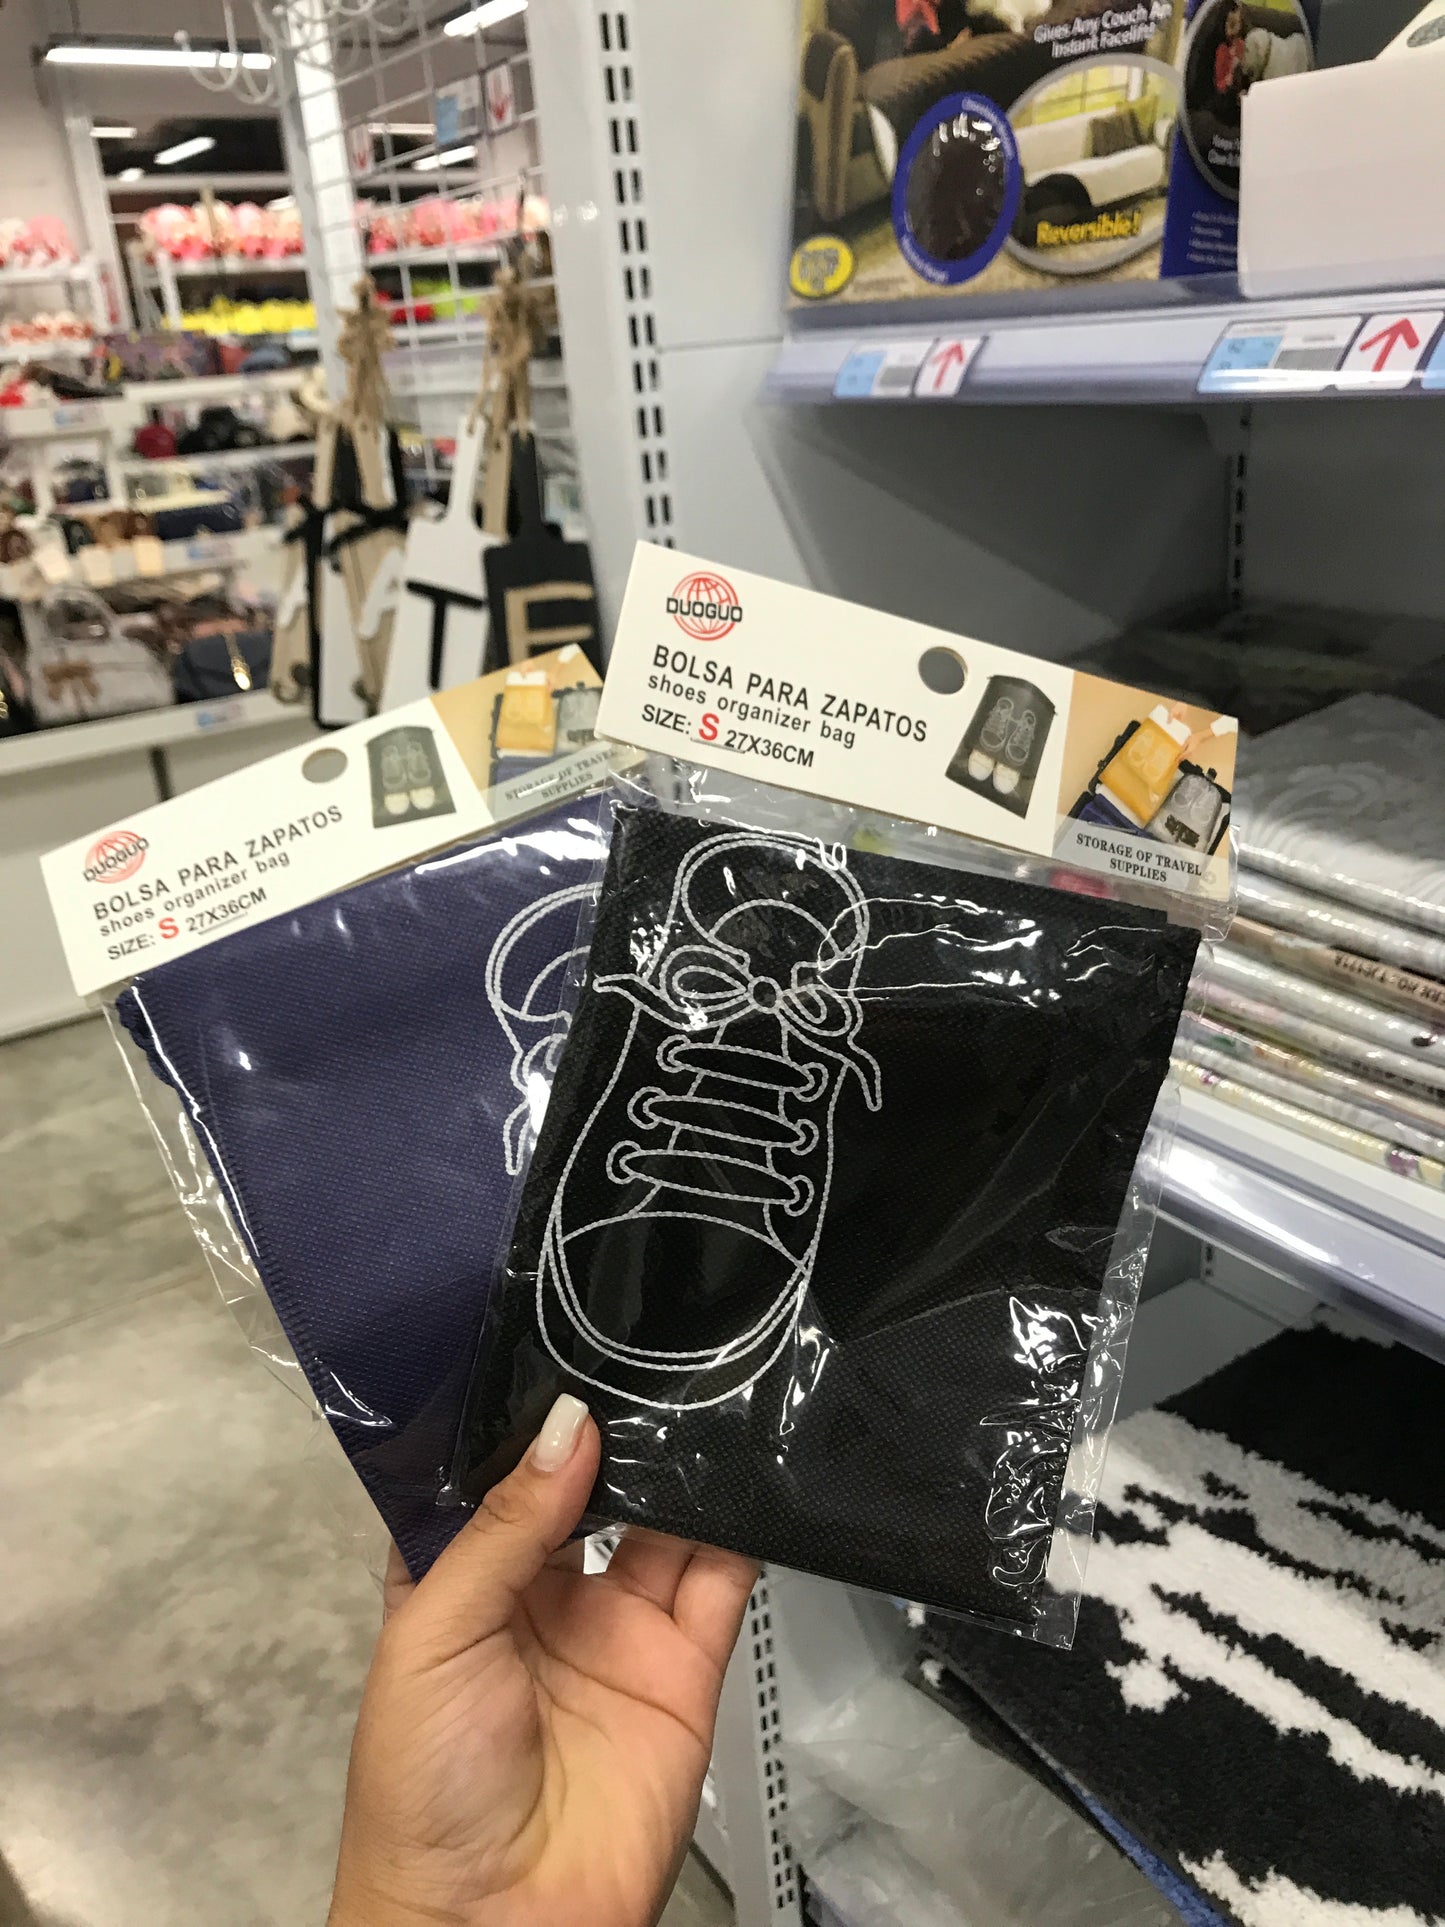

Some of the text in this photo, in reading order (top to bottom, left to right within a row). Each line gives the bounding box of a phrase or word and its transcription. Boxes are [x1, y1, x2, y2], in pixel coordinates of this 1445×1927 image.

[1034, 23, 1071, 43] Gives
[1071, 17, 1100, 36] Any
[1102, 3, 1148, 29] Couch
[1052, 35, 1099, 58] Instant
[1036, 209, 1141, 245] Reversible!
[666, 597, 743, 623] DUOGUO
[648, 674, 856, 749] shoes organizer bag
[653, 644, 927, 742] BOLSA PARA ZAPATOS
[641, 703, 815, 767] SIZE: S 27X36CM
[541, 772, 593, 799] SUPPLIES
[93, 805, 343, 920] BOLSA PARA ZAPATOS
[1076, 832, 1202, 876] STORAGE OF TRAVEL
[1110, 858, 1167, 883] SUPPLIES
[99, 852, 290, 937] shoes organizer bag
[107, 887, 267, 960] SIZE: S 27X36CM
